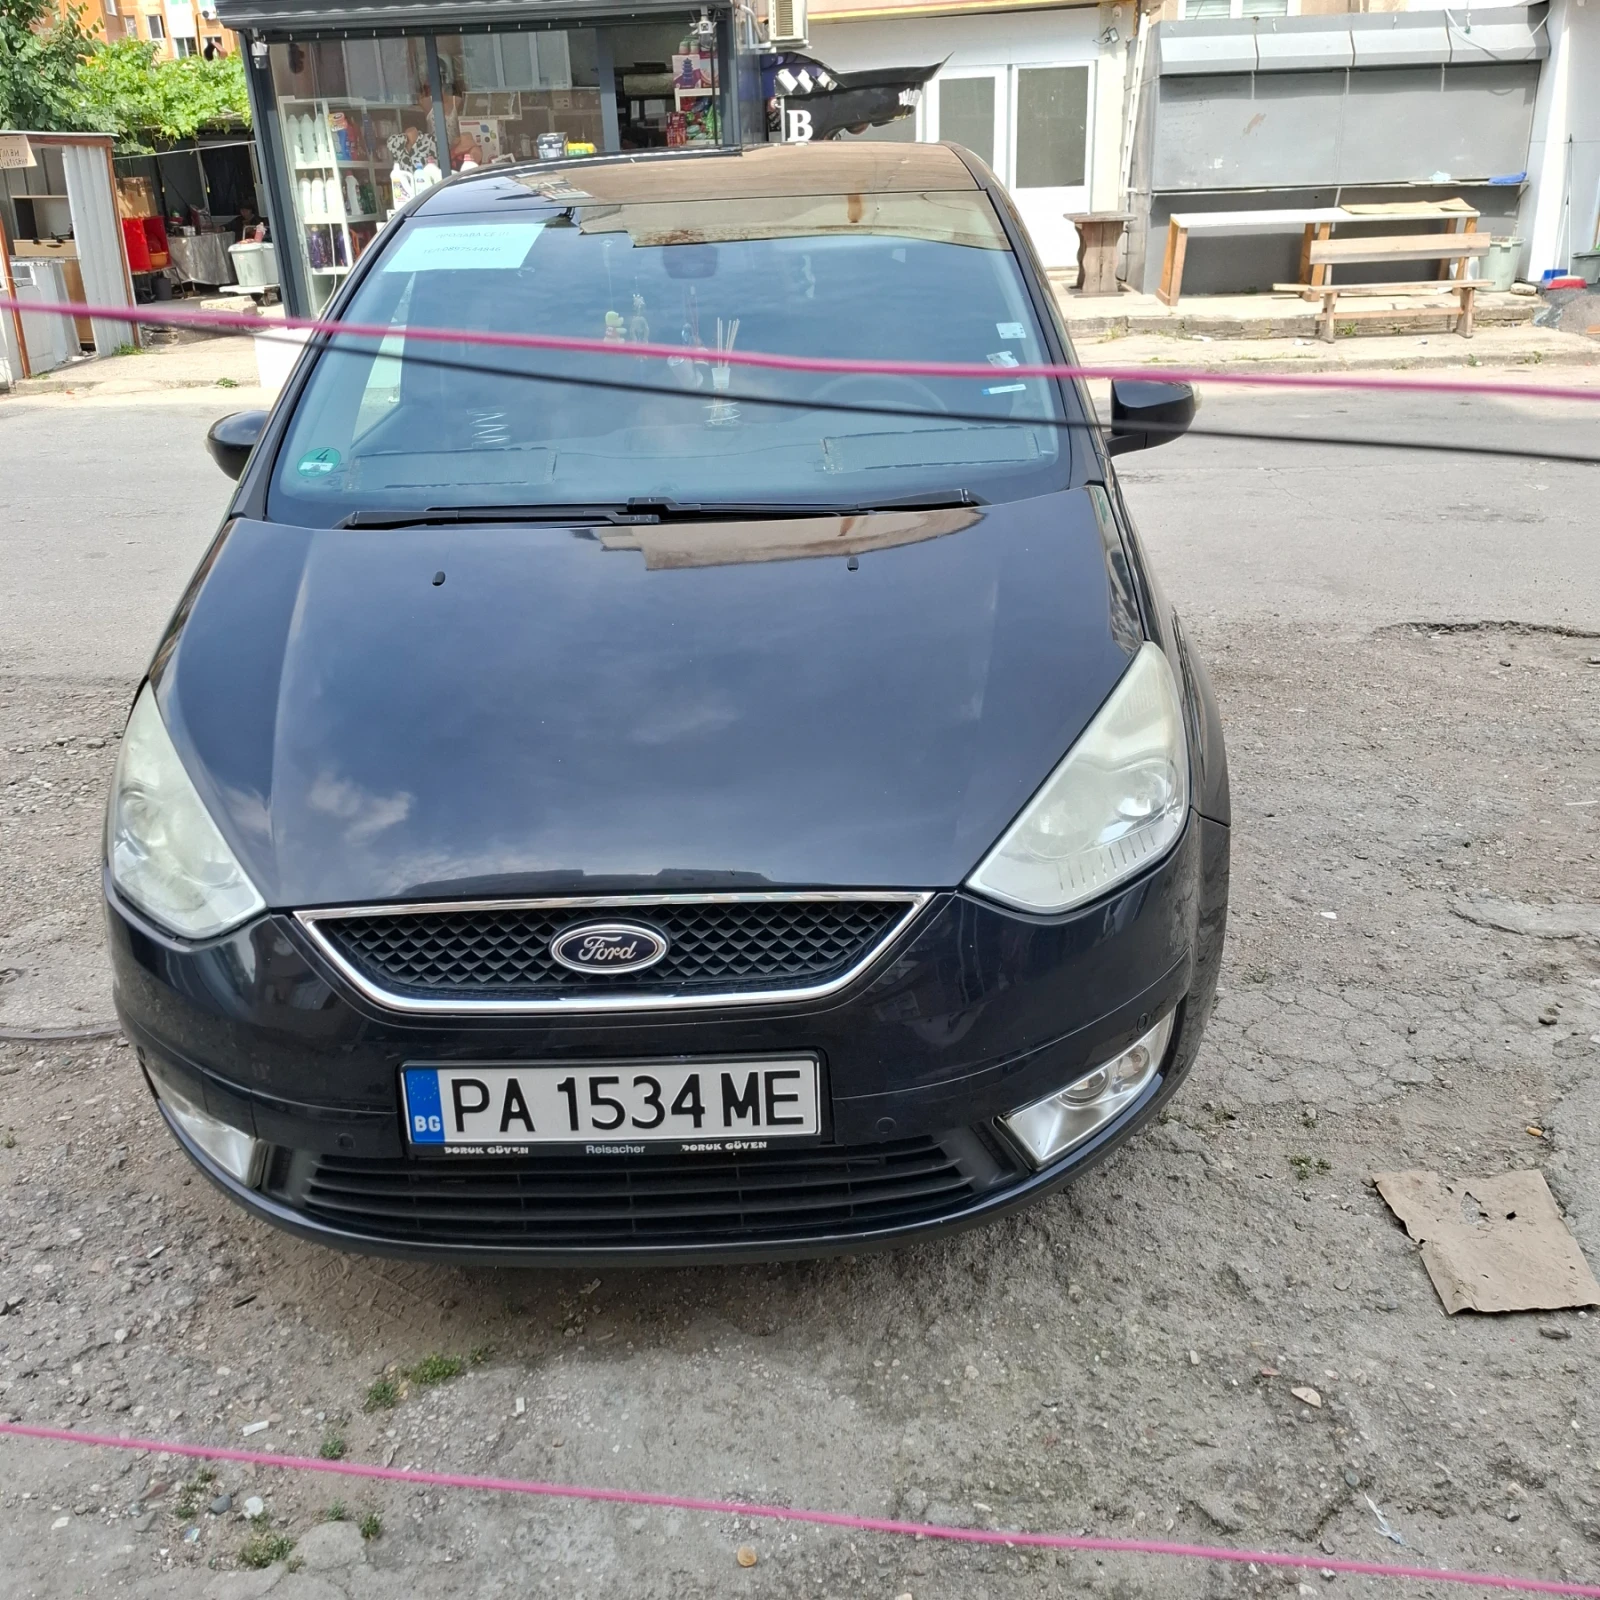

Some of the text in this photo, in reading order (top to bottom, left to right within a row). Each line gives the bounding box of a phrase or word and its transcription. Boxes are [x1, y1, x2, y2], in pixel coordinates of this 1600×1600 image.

[315, 448, 330, 462] 4
[578, 936, 637, 961] Ford
[450, 1069, 804, 1133] PA 1534 ME
[414, 1115, 441, 1132] BG
[586, 1144, 646, 1155] Reisacher
[725, 1140, 767, 1151] GÜVEN
